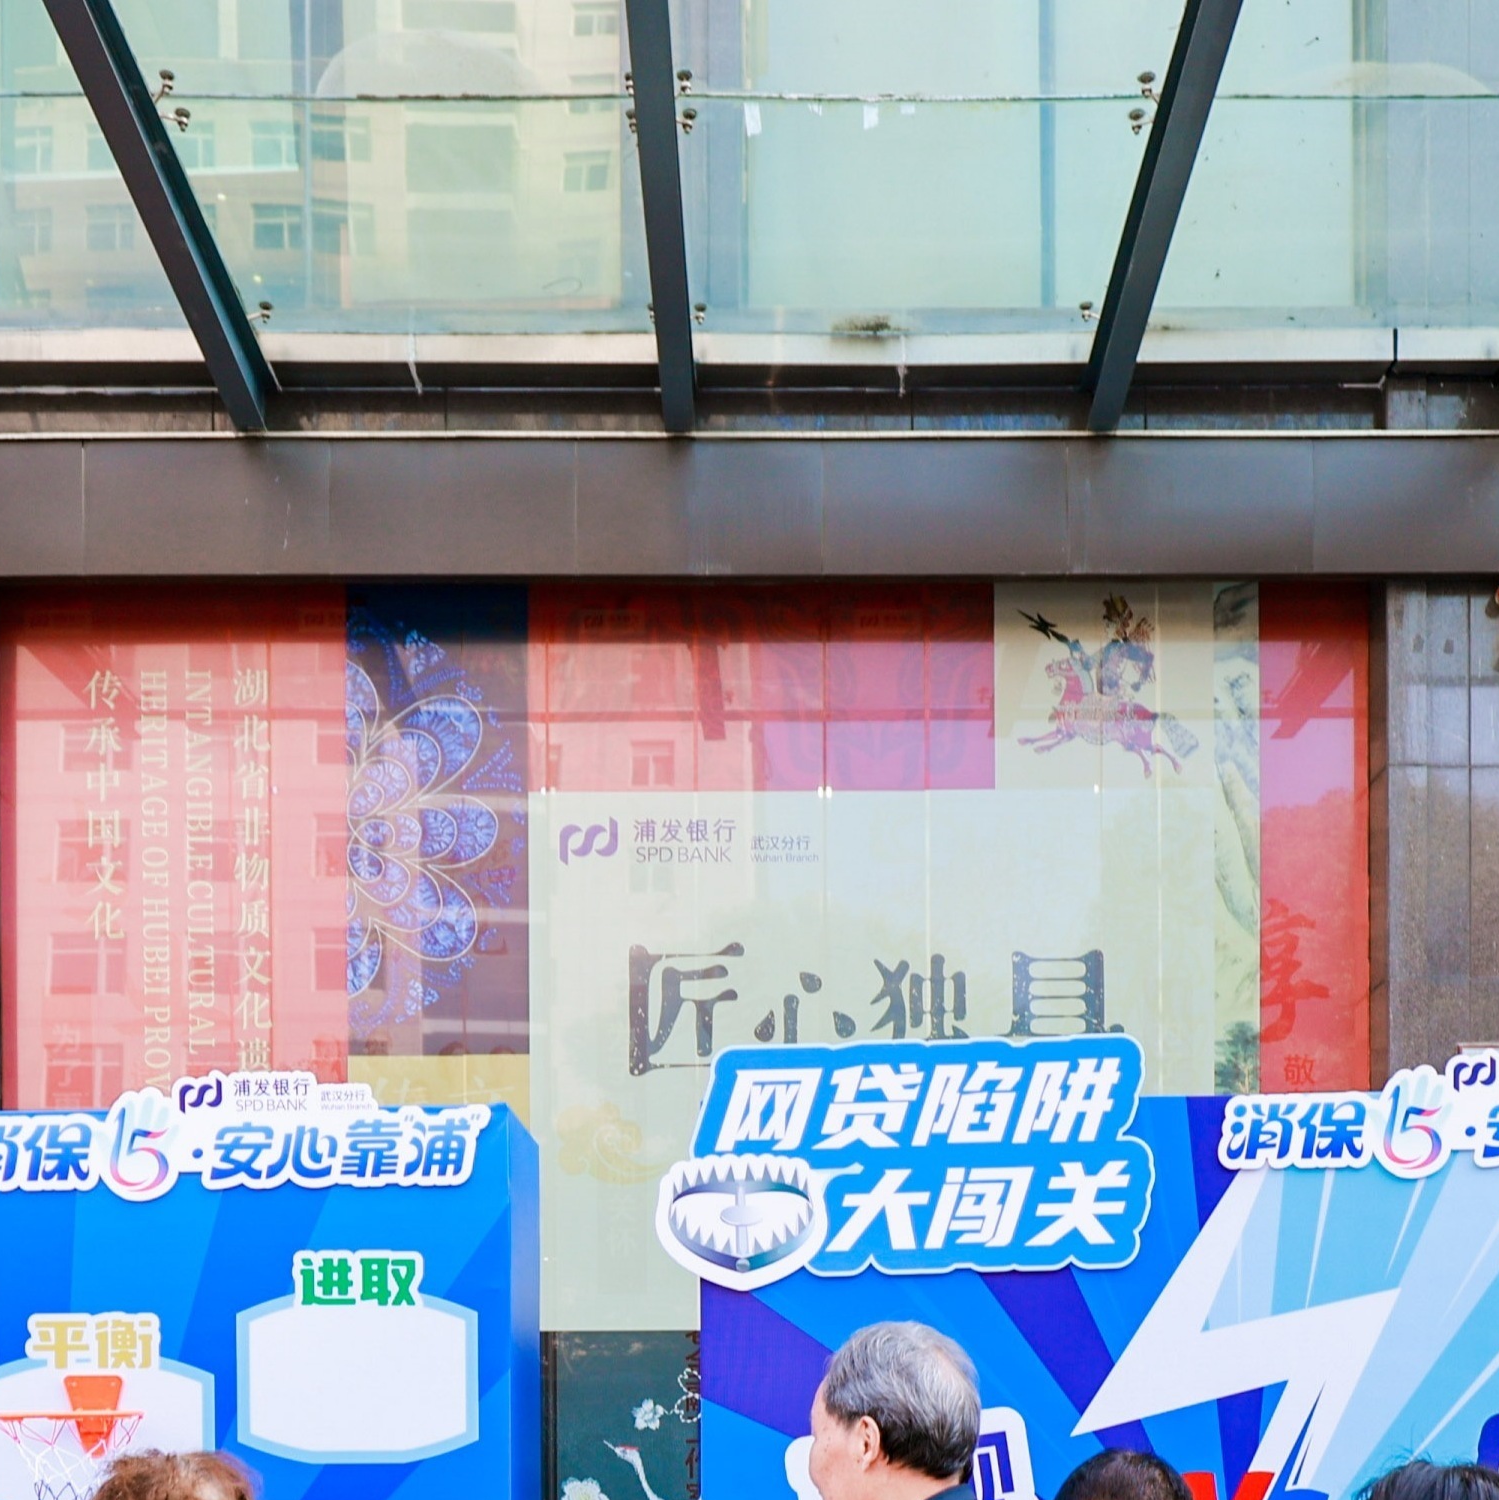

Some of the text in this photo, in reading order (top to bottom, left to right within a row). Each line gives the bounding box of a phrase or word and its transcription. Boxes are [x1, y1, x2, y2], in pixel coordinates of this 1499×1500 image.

[140, 670, 169, 837] HERITAGE
[83, 669, 126, 942] 传承中国文化
[633, 819, 736, 844] 浦发银行
[635, 845, 732, 864] SPD BANK
[750, 836, 811, 850] 武汉分行
[141, 847, 169, 888] OF
[185, 670, 217, 1056] INTANGIBLE CULTURAL
[233, 668, 272, 1072] 湖北省非物质文化遗
[750, 852, 819, 864] Wuhan Branch
[142, 896, 171, 1003] HUBEI
[629, 942, 1125, 1077] 匠心独具
[233, 1078, 311, 1098] 浦发银行
[235, 1098, 309, 1113] SPD BANK
[320, 1090, 367, 1102] 武汉分行
[714, 1057, 1120, 1154] 网贷陷阱
[825, 1161, 1131, 1254] 大闯关
[300, 1257, 417, 1307] 进取
[32, 1319, 159, 1370] 平衡
